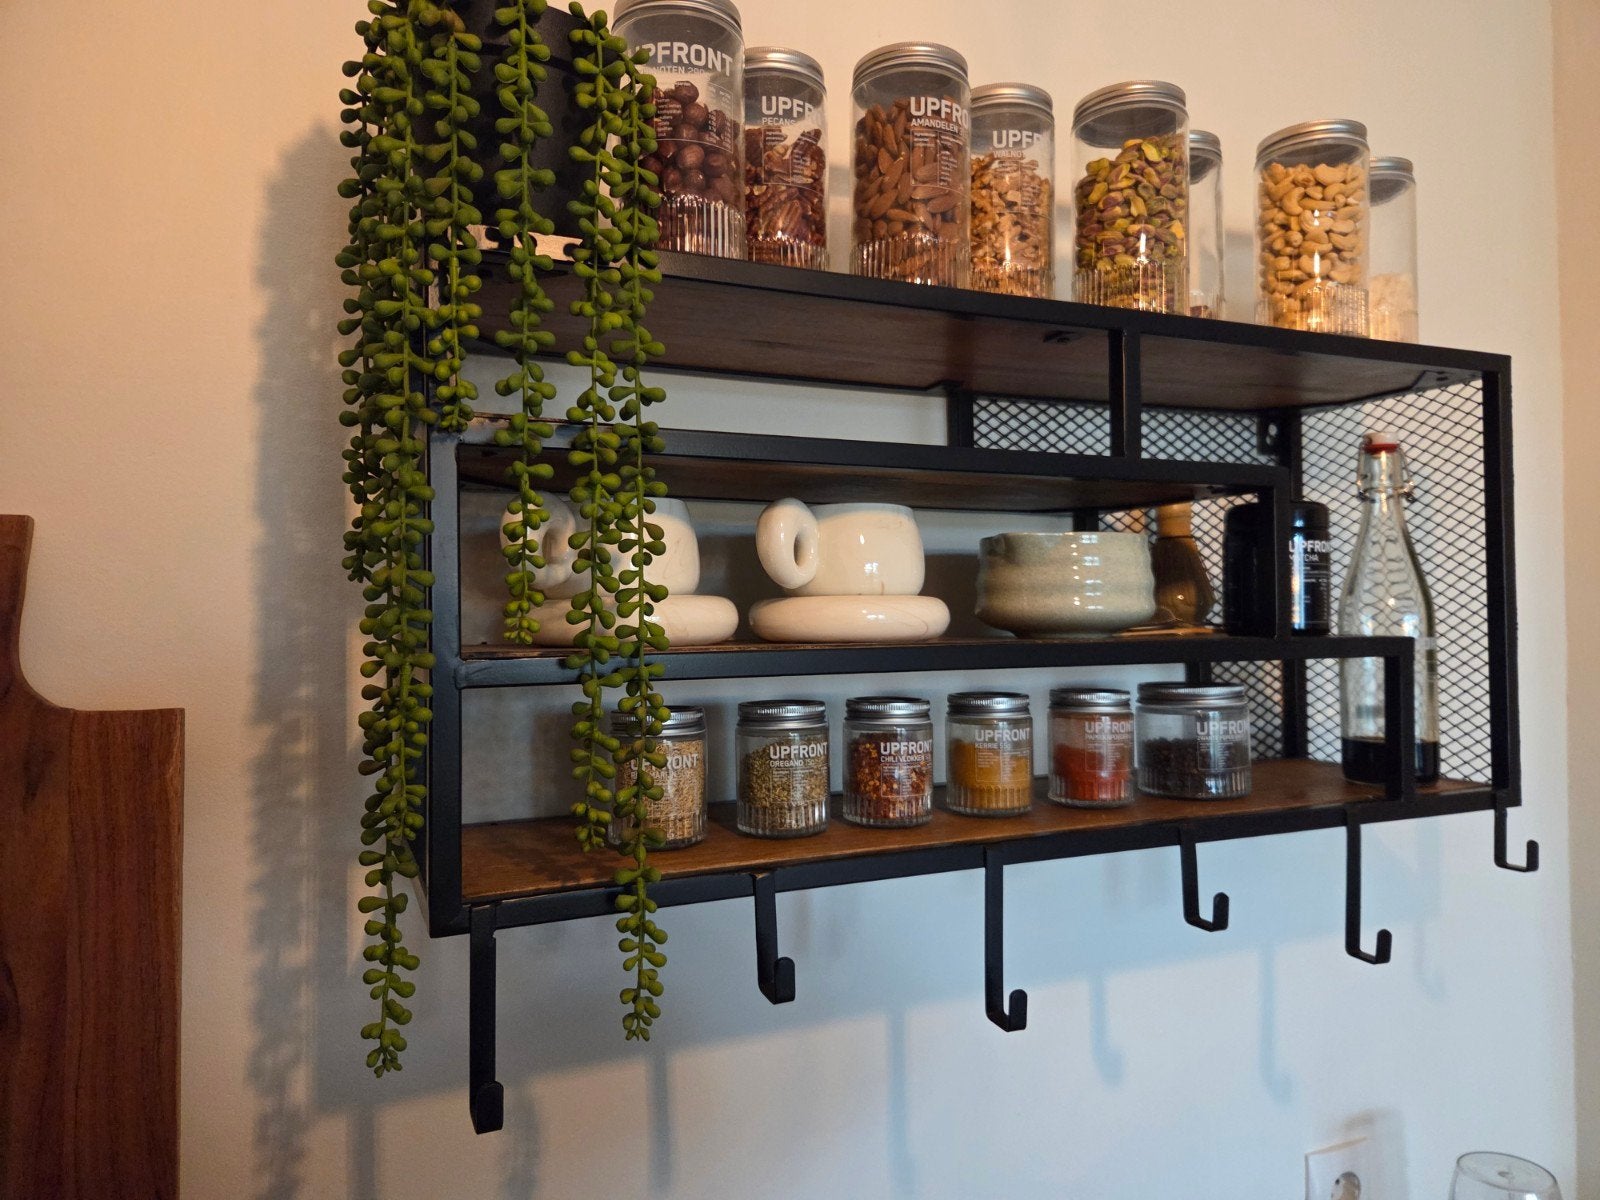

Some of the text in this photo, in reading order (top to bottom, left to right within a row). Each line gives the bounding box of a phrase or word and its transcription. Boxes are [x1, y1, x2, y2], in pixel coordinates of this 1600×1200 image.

[628, 41, 734, 77] PFRONT
[975, 727, 1030, 742] UPFRONT
[770, 742, 828, 760] UPFRONT
[880, 739, 932, 755] UPFRONT
[770, 759, 804, 767] OREGANO
